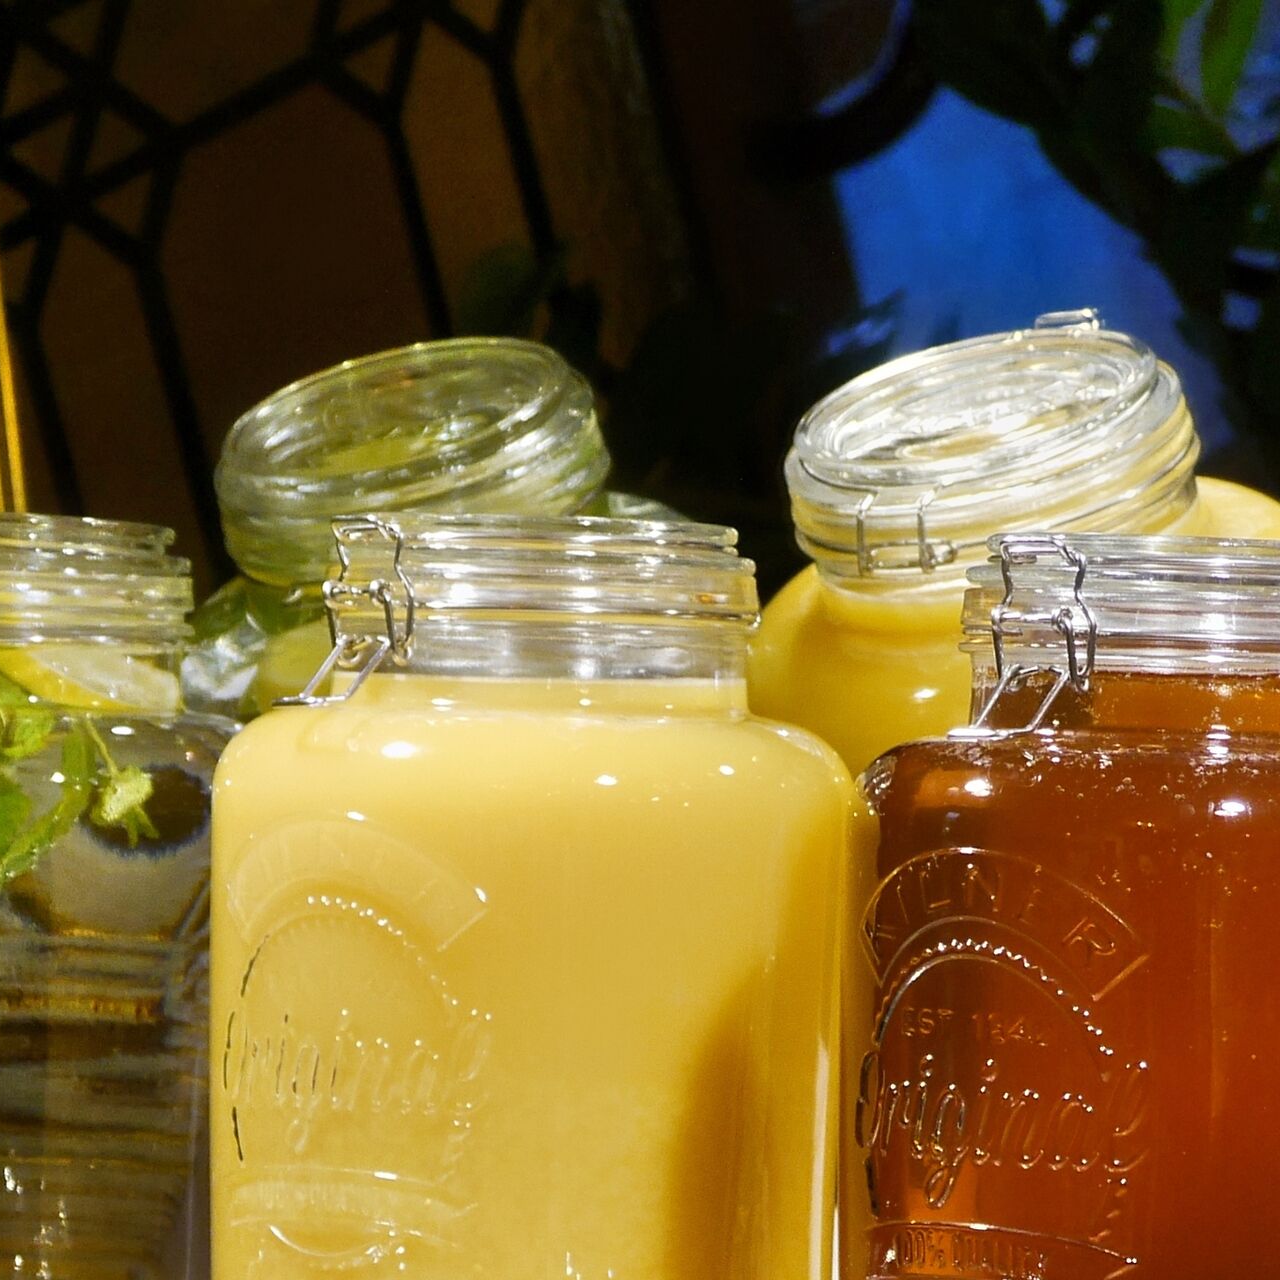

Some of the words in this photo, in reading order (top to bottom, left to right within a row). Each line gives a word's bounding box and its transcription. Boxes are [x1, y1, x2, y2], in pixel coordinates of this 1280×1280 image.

[223, 1009, 492, 1153] Original
[901, 1005, 954, 1038] EST
[856, 1050, 1149, 1210] Original
